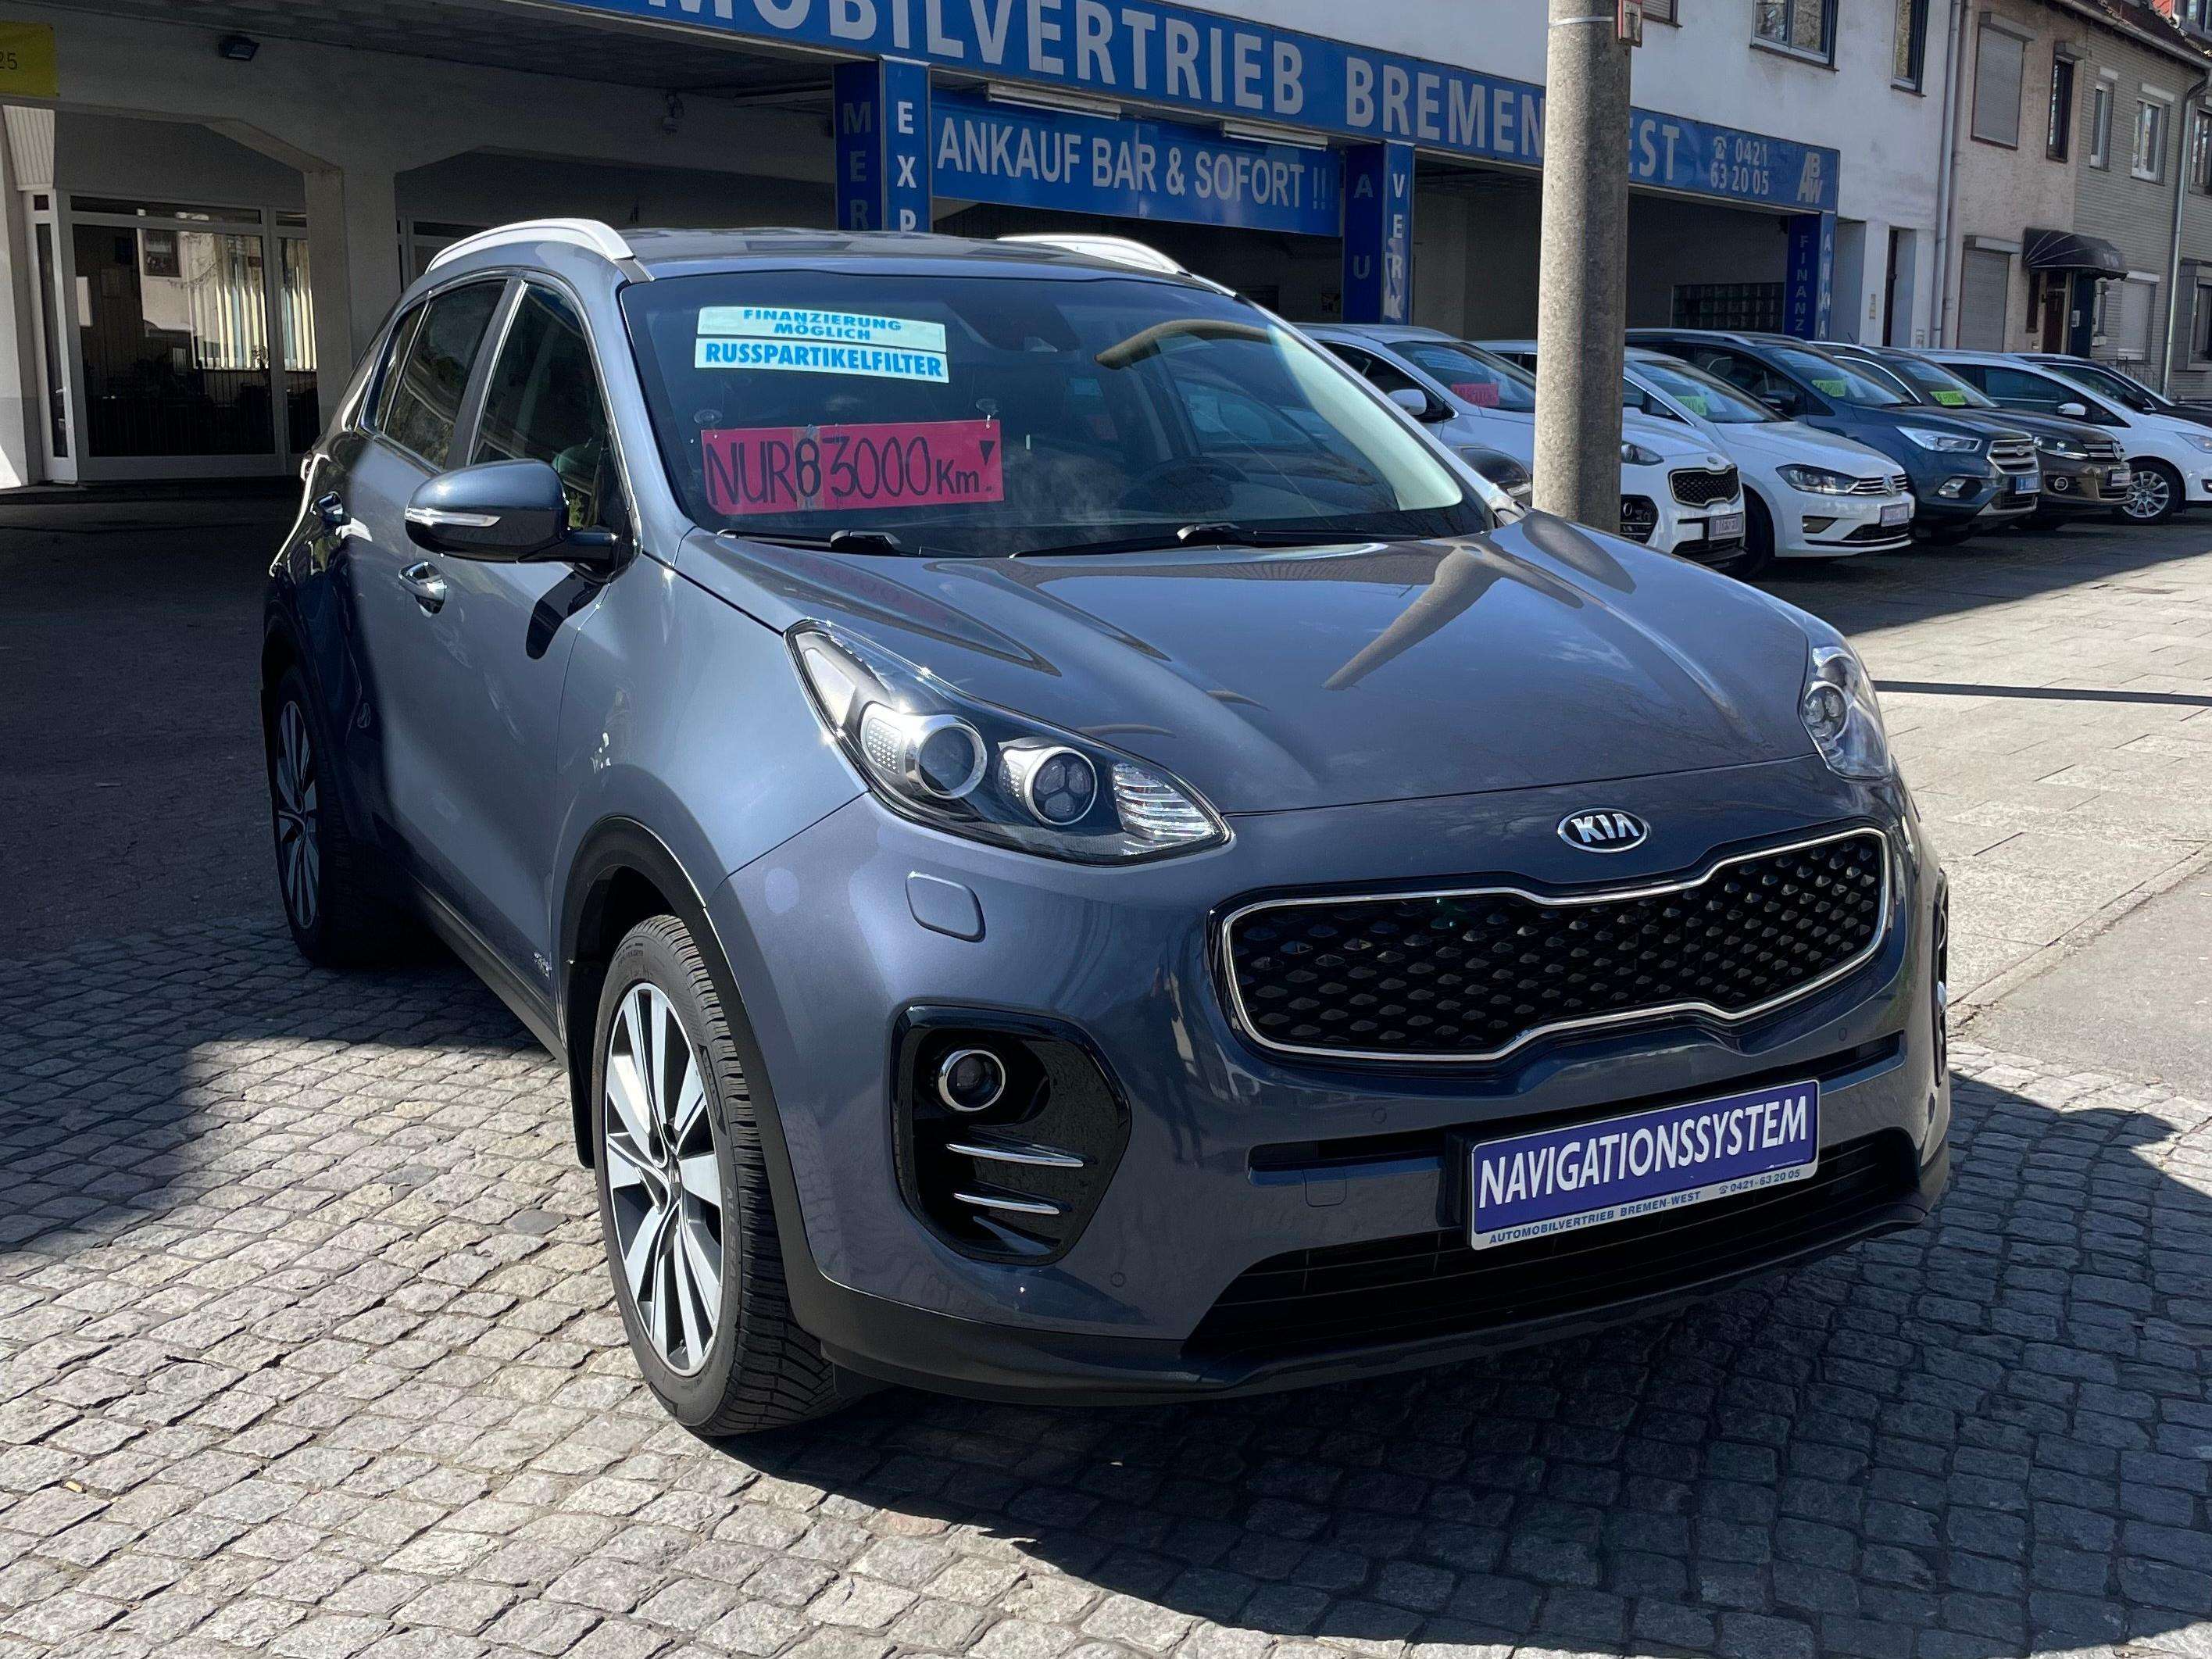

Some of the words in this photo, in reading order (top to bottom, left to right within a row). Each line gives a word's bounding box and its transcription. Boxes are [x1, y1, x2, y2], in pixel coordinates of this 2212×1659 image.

[649, 0, 1303, 115] ILVERTRIEB
[1346, 57, 1545, 156] BREMEN
[1628, 117, 1680, 181] ST
[896, 101, 917, 233] EXP
[937, 117, 1081, 184] ANKAUF
[1092, 138, 1156, 194] BAR
[1166, 147, 1186, 196] &
[1195, 151, 1305, 209] SOFORT
[1710, 161, 1727, 189] 63
[1731, 165, 1749, 193] 20
[1753, 169, 1769, 195] 05
[1735, 138, 1768, 167] 0421
[1795, 235, 1809, 331] FINANZ
[743, 309, 902, 331] FINANZIERUNG
[706, 342, 943, 377] RUSSPARTIKELFILTER
[1571, 813, 1640, 843] KIA
[1478, 1095, 1807, 1209] NAVIGATIONSSYSTEM
[1488, 1209, 1614, 1245] AUTOMOBILVERTRIEB
[1620, 1190, 1702, 1217] BREMEN-WEST
